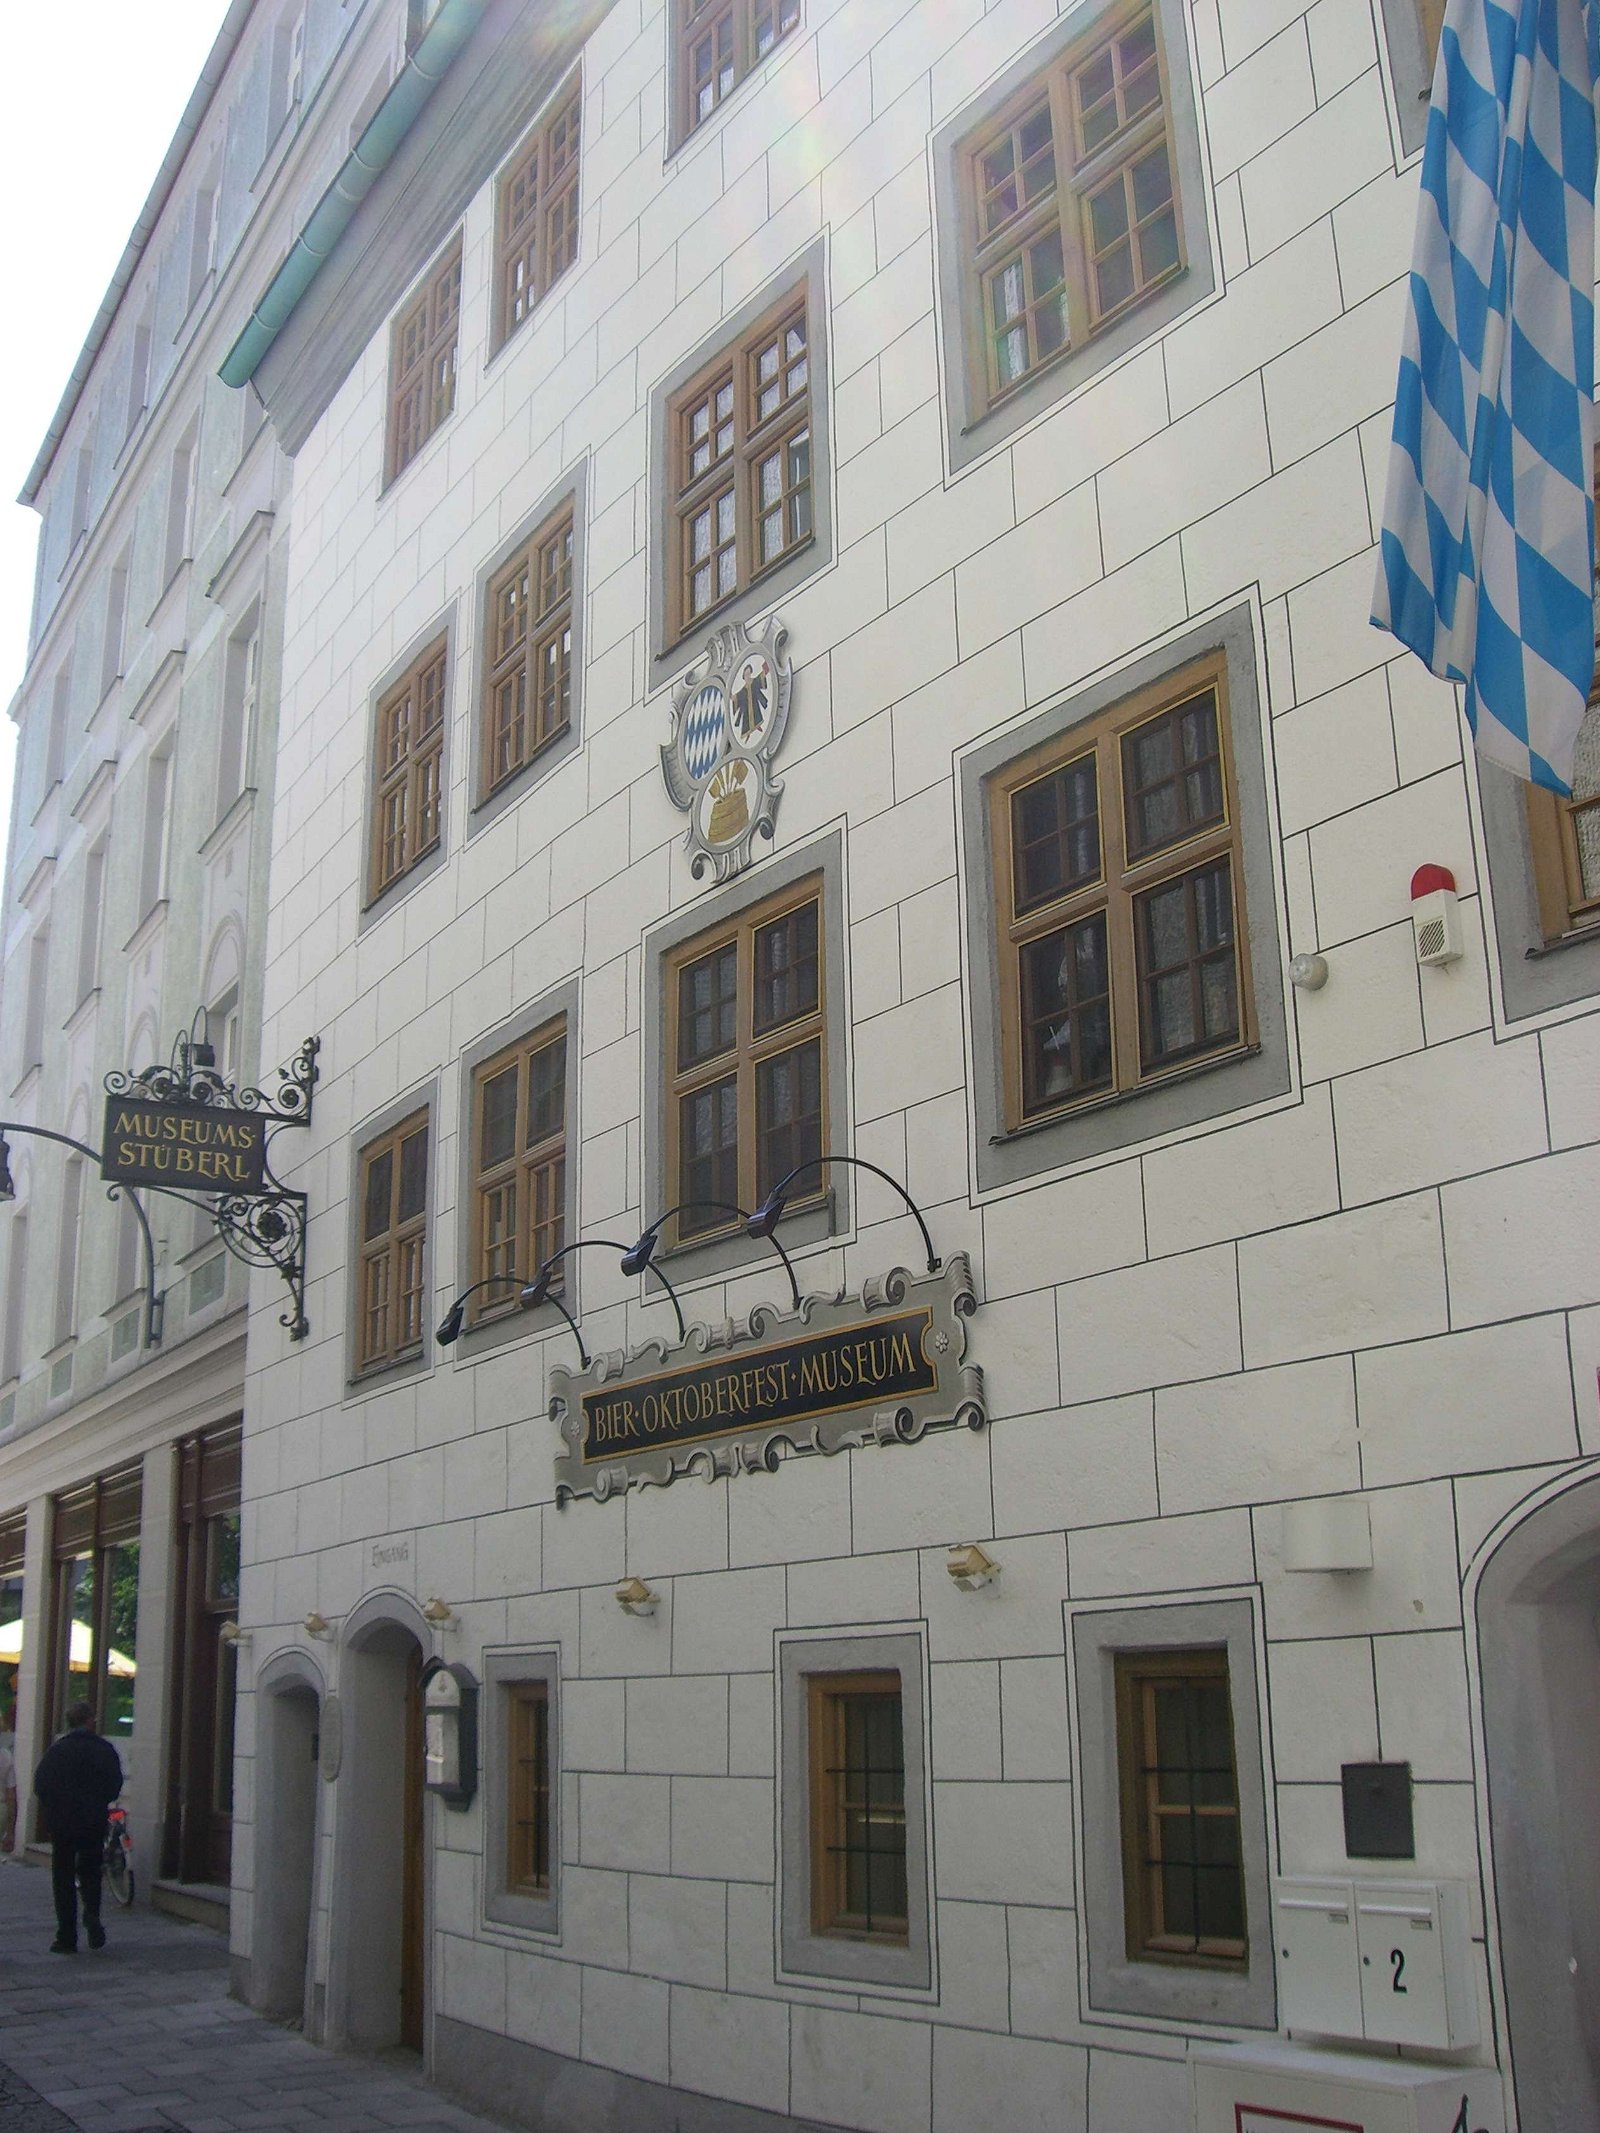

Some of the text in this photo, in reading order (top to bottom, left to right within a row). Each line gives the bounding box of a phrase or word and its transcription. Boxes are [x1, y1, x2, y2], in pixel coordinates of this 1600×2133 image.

[113, 1112, 253, 1149] MUSEUMS
[117, 1142, 250, 1182] STÜBERL
[799, 1332, 916, 1396] MUSEUM
[1390, 1949, 1408, 1993] 2
